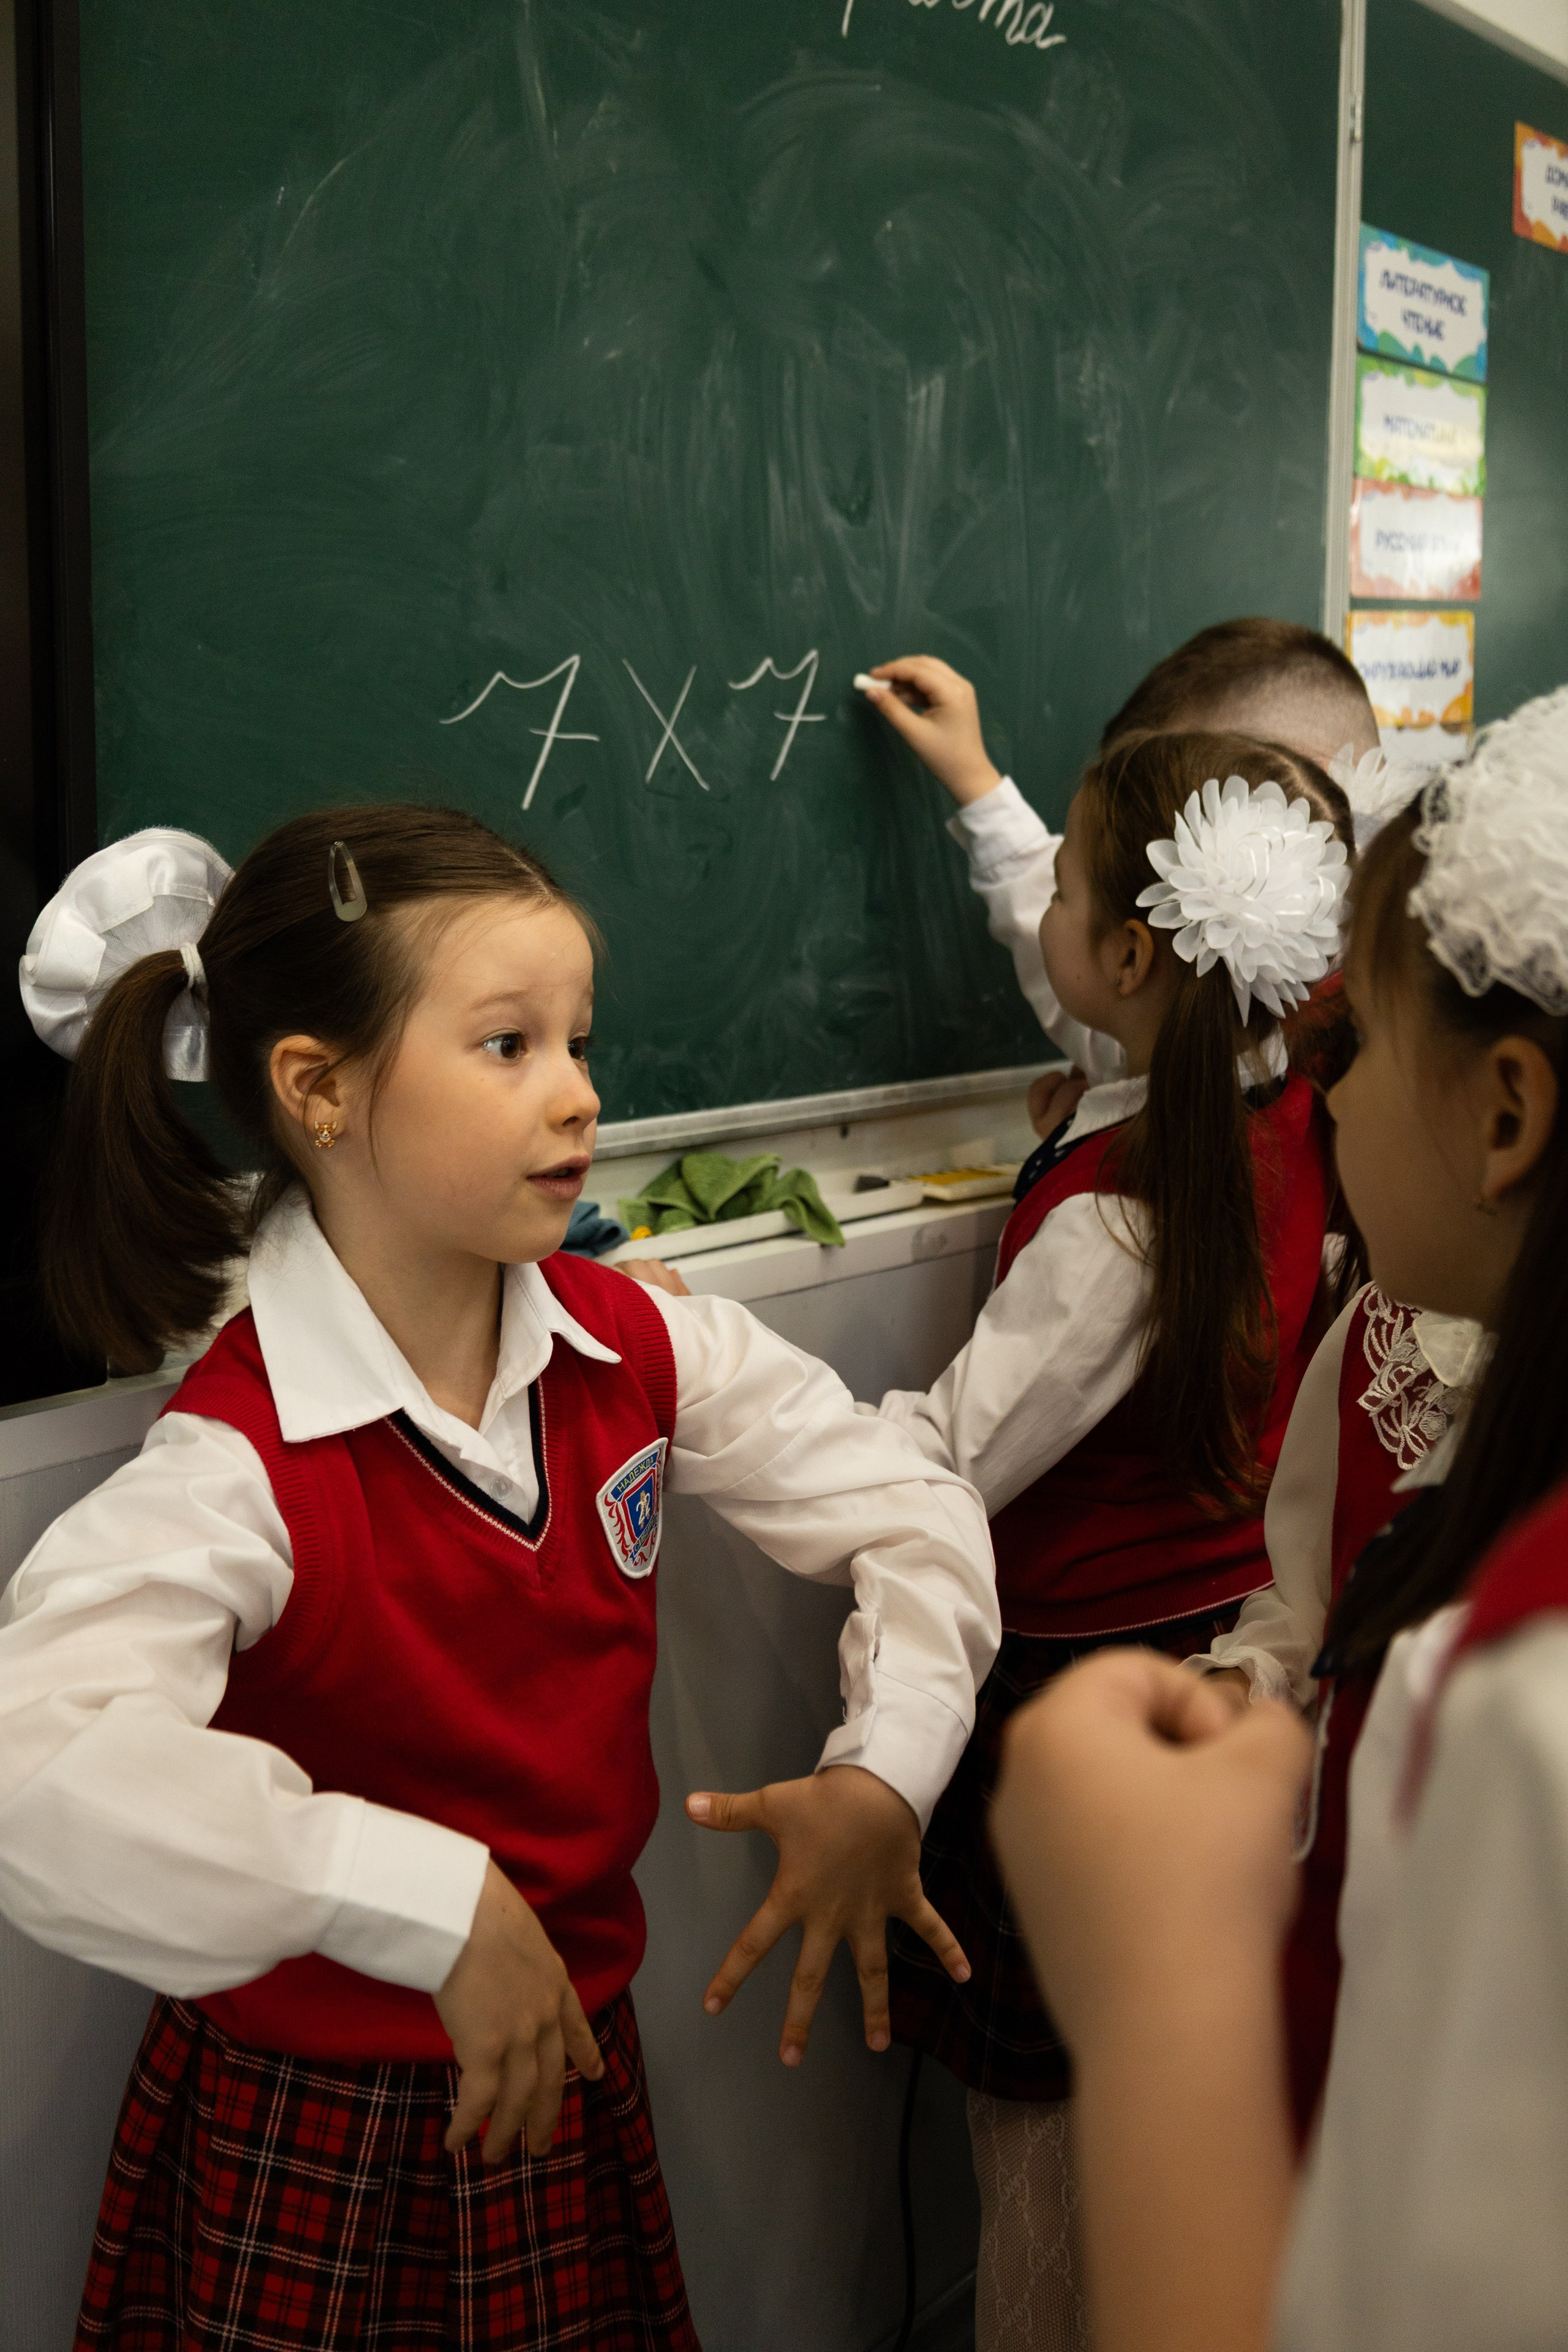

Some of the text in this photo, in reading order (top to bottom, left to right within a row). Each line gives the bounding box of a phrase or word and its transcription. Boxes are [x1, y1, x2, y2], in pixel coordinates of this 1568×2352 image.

[1382, 268, 1467, 317] ЛИТЕРАТУРНОЕ
[439, 653, 599, 810] 7
[728, 649, 827, 781] 7
[617, 1456, 654, 1492] НАДЕЖДА
